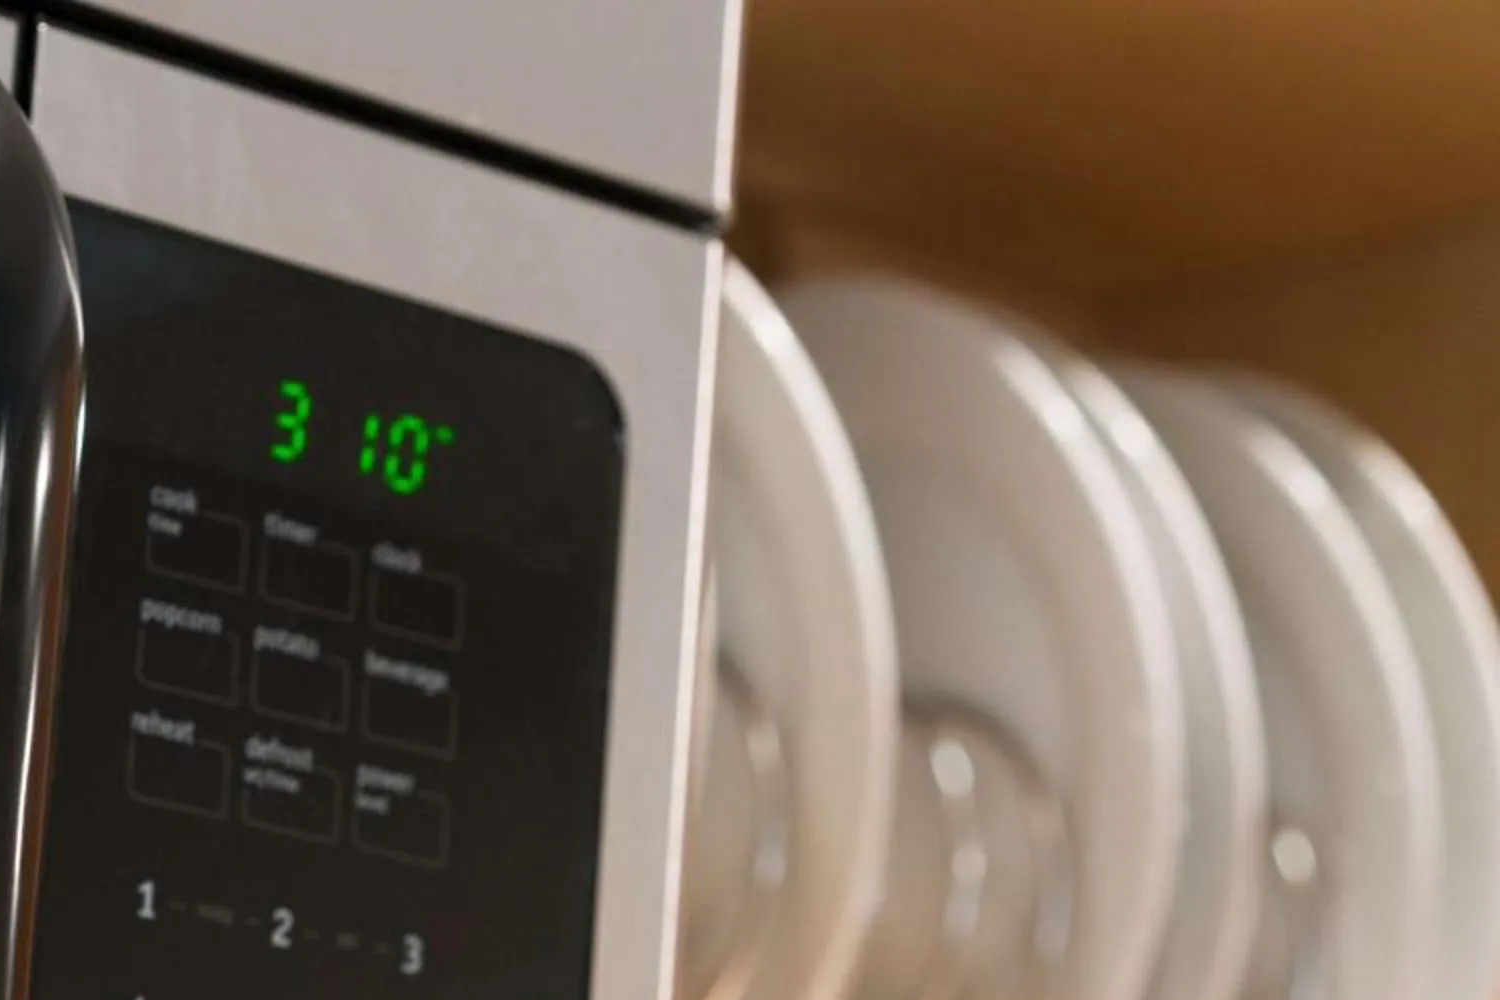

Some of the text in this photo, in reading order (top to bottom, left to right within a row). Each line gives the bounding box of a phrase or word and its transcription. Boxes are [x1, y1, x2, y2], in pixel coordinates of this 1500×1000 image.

[270, 379, 312, 462] 3
[140, 597, 223, 634] popcorn
[137, 881, 156, 920] 1
[270, 907, 294, 949] 2
[400, 934, 423, 975] 3
